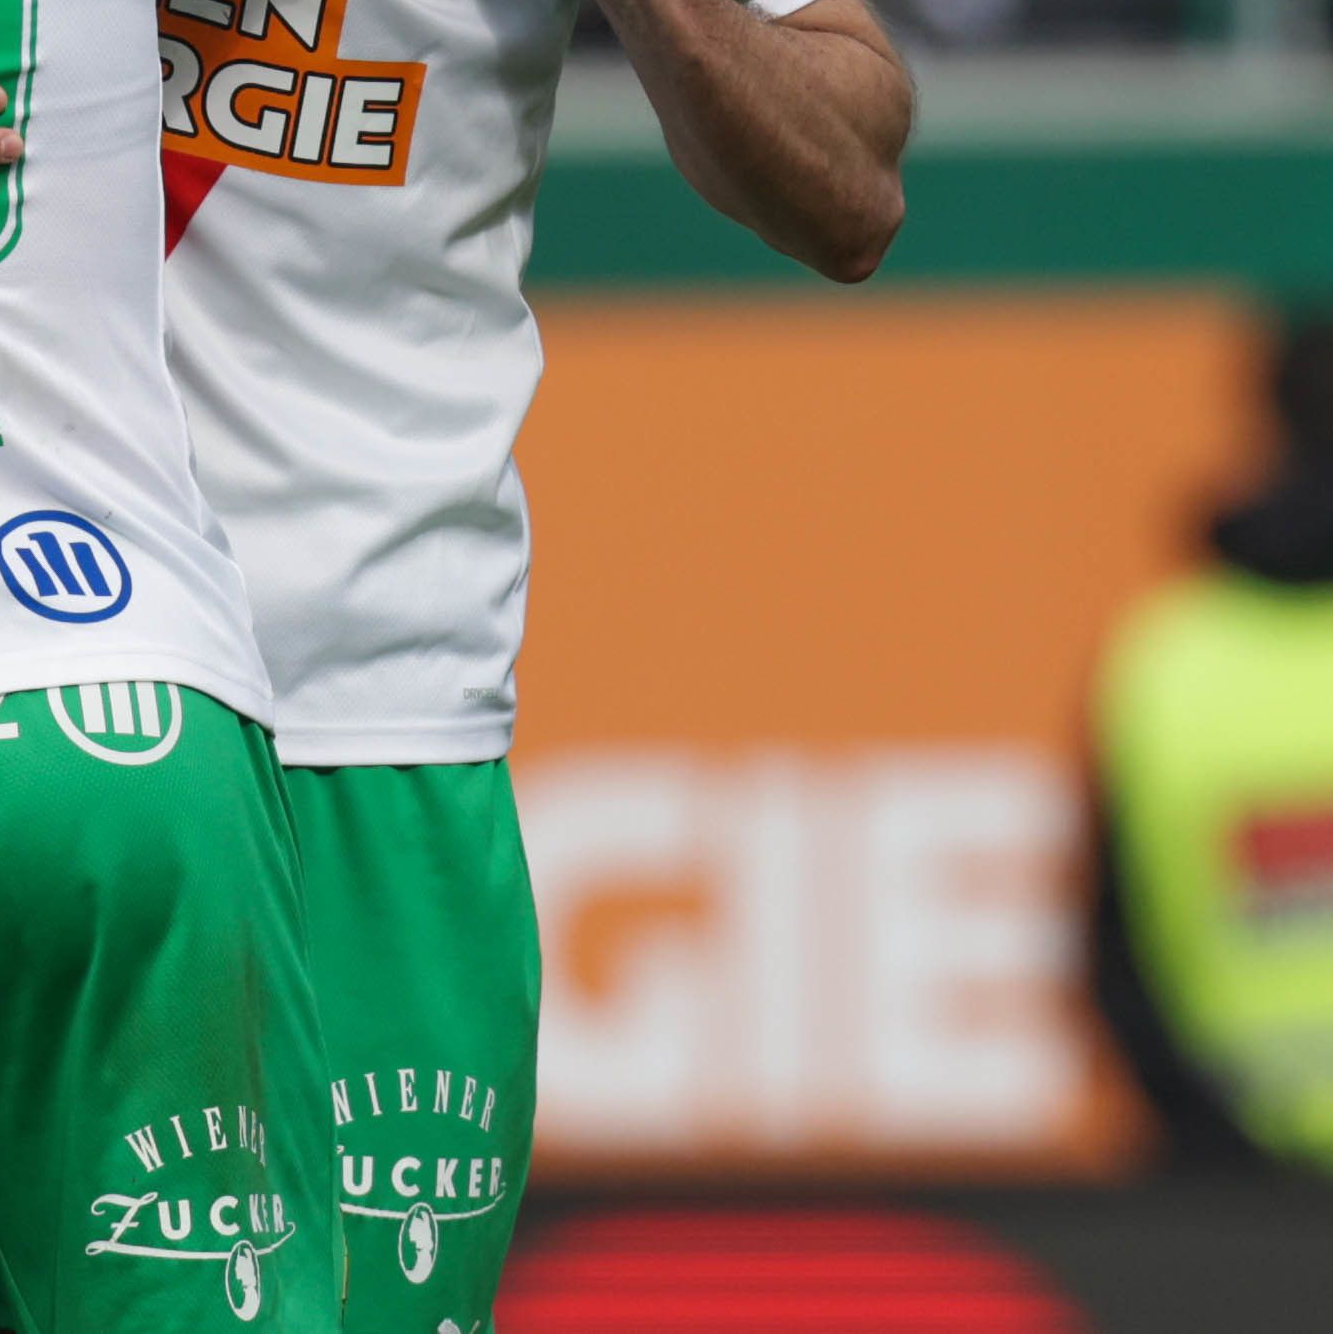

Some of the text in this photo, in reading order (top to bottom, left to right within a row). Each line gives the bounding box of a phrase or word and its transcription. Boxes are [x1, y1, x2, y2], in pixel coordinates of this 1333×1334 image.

[124, 1105, 267, 1173] WIENER
[336, 1144, 503, 1198] UCKER
[85, 1191, 288, 1260] ZUCKER
